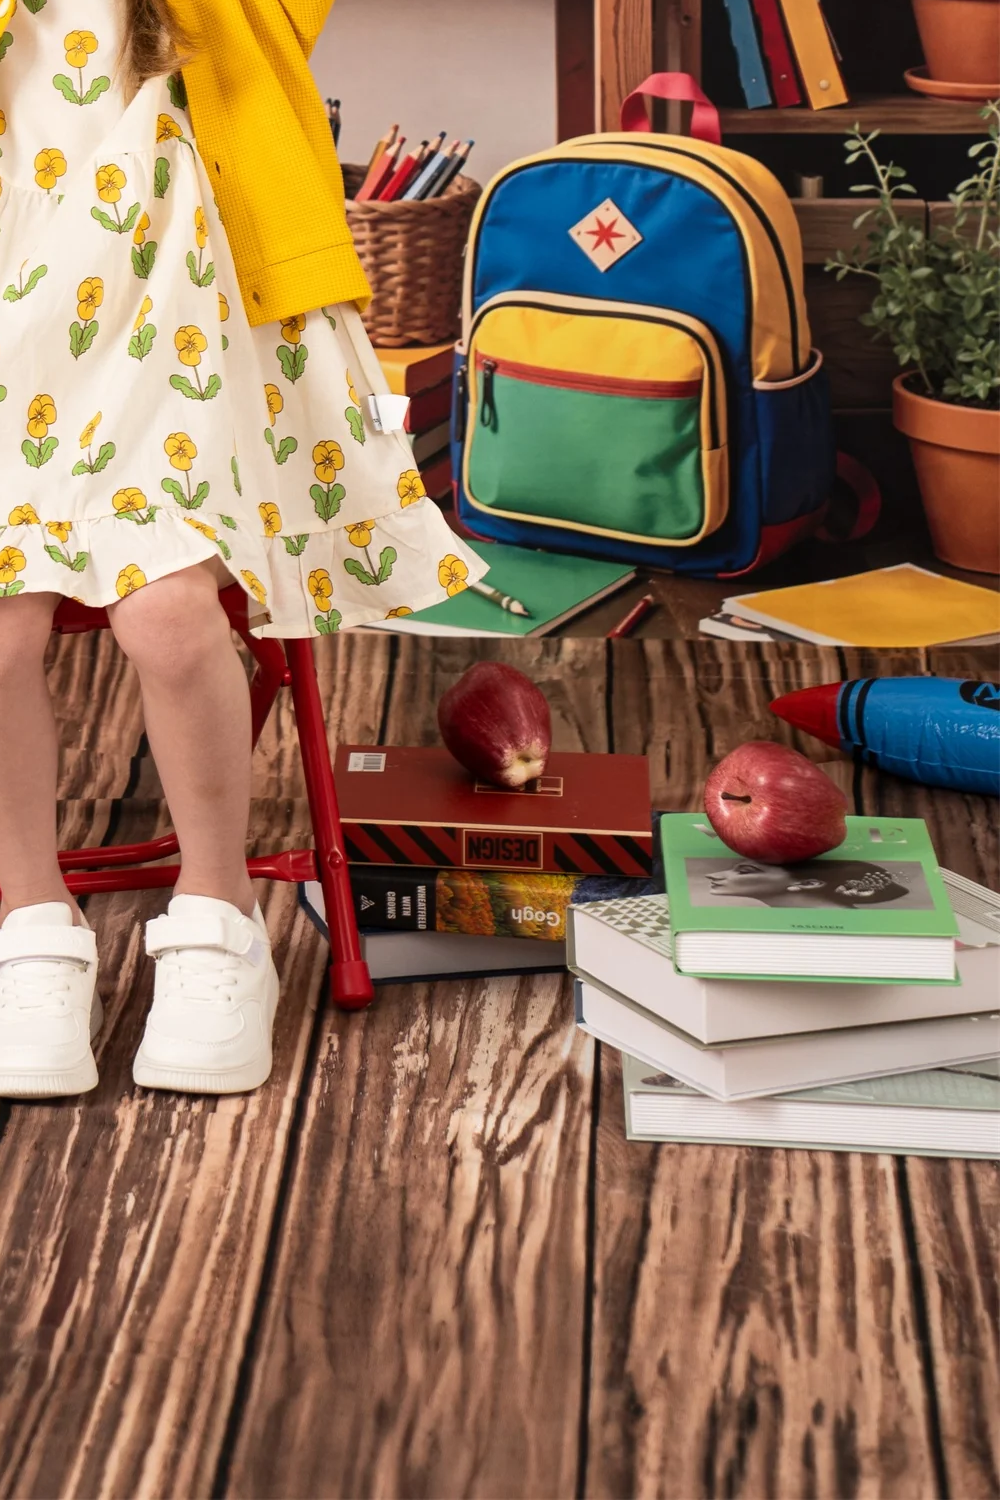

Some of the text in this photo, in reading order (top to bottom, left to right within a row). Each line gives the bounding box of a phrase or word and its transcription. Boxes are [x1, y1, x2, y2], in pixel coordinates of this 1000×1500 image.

[467, 835, 539, 863] DESIGN
[386, 891, 397, 920] CROWS
[401, 895, 412, 917] WITH
[416, 885, 427, 930] WHEATFIELD
[511, 907, 561, 927] Gogh
